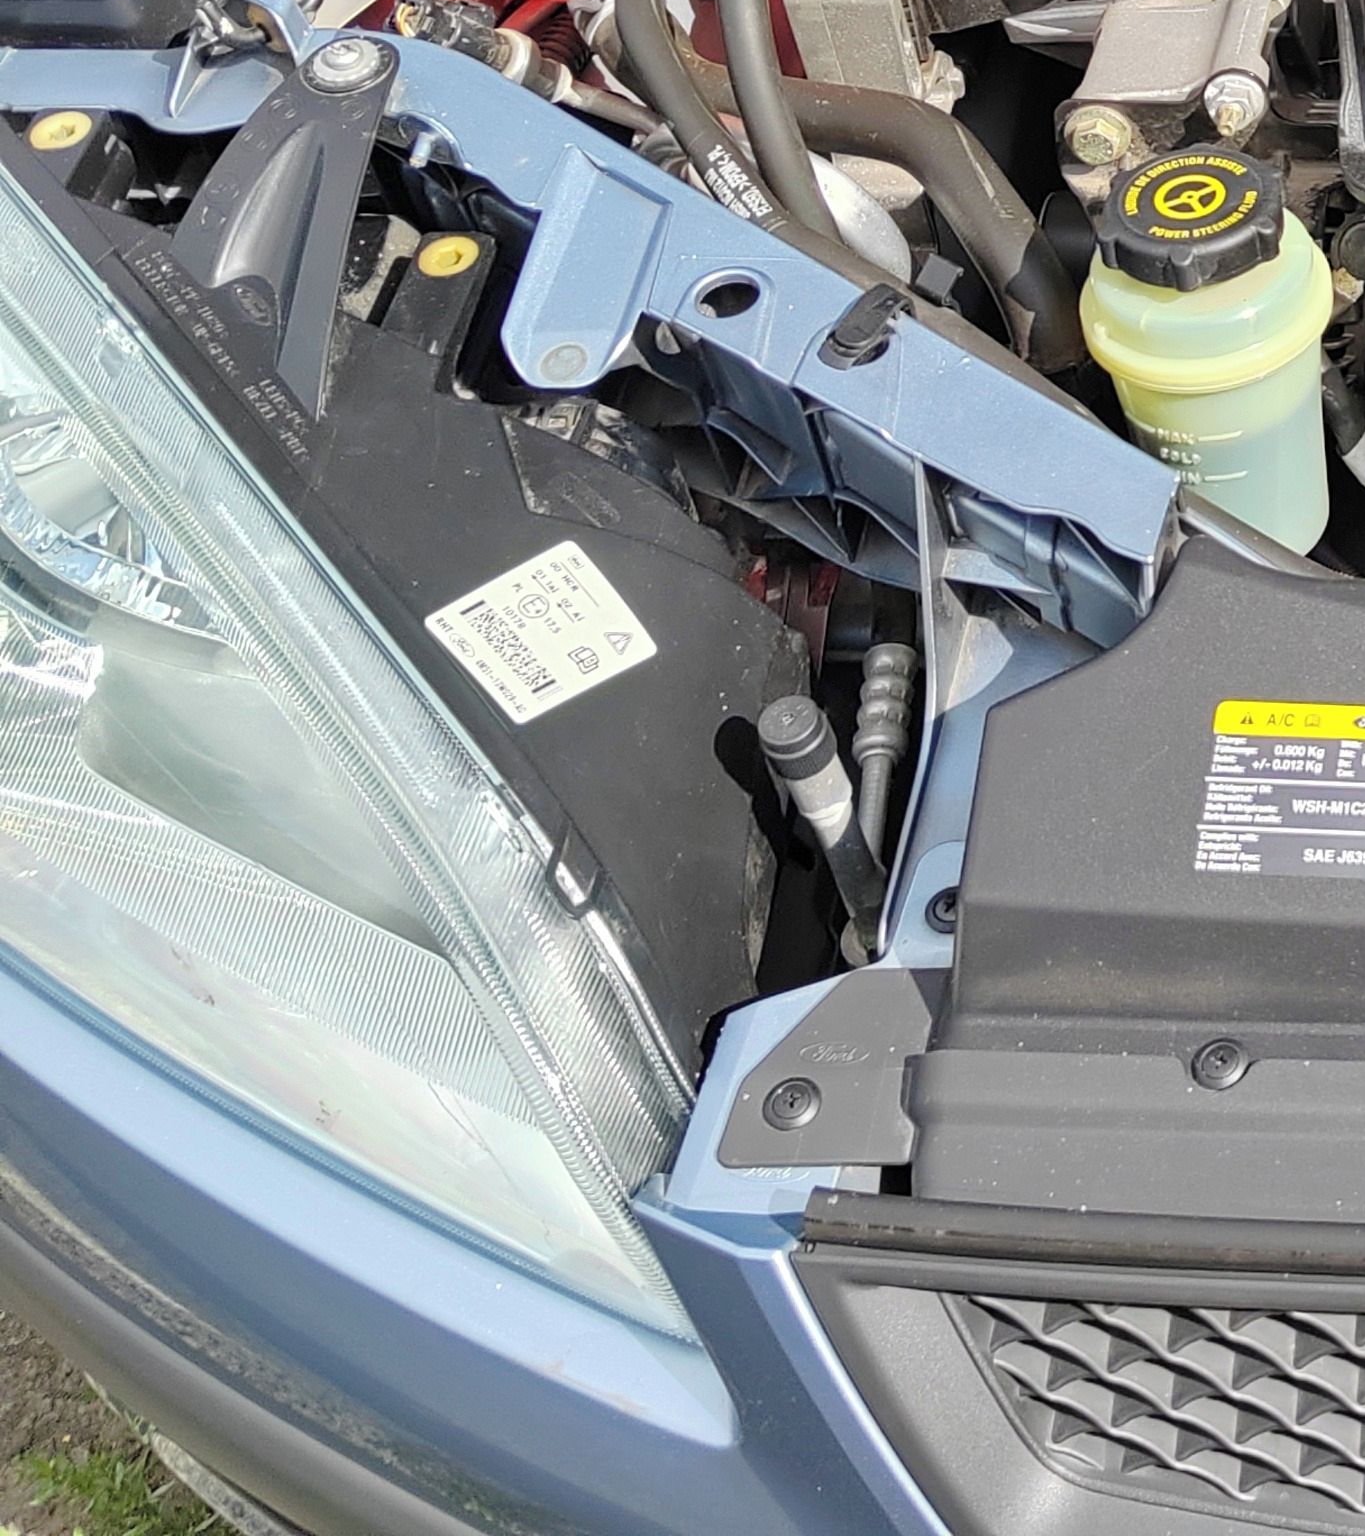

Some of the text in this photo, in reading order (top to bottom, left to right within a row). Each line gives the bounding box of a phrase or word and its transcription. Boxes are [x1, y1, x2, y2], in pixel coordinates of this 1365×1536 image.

[1147, 155, 1206, 180] DIRECTION
[1148, 190, 1259, 240] POWER STEERING FLUID
[1157, 427, 1195, 445] MAX
[1267, 713, 1295, 727] A/C
[1307, 745, 1326, 760] Kg
[1252, 757, 1271, 770] +/-
[1271, 759, 1304, 771] 0.012
[1305, 759, 1324, 775] Kg
[1303, 848, 1336, 863] SAE
[812, 1044, 858, 1064] Ford
